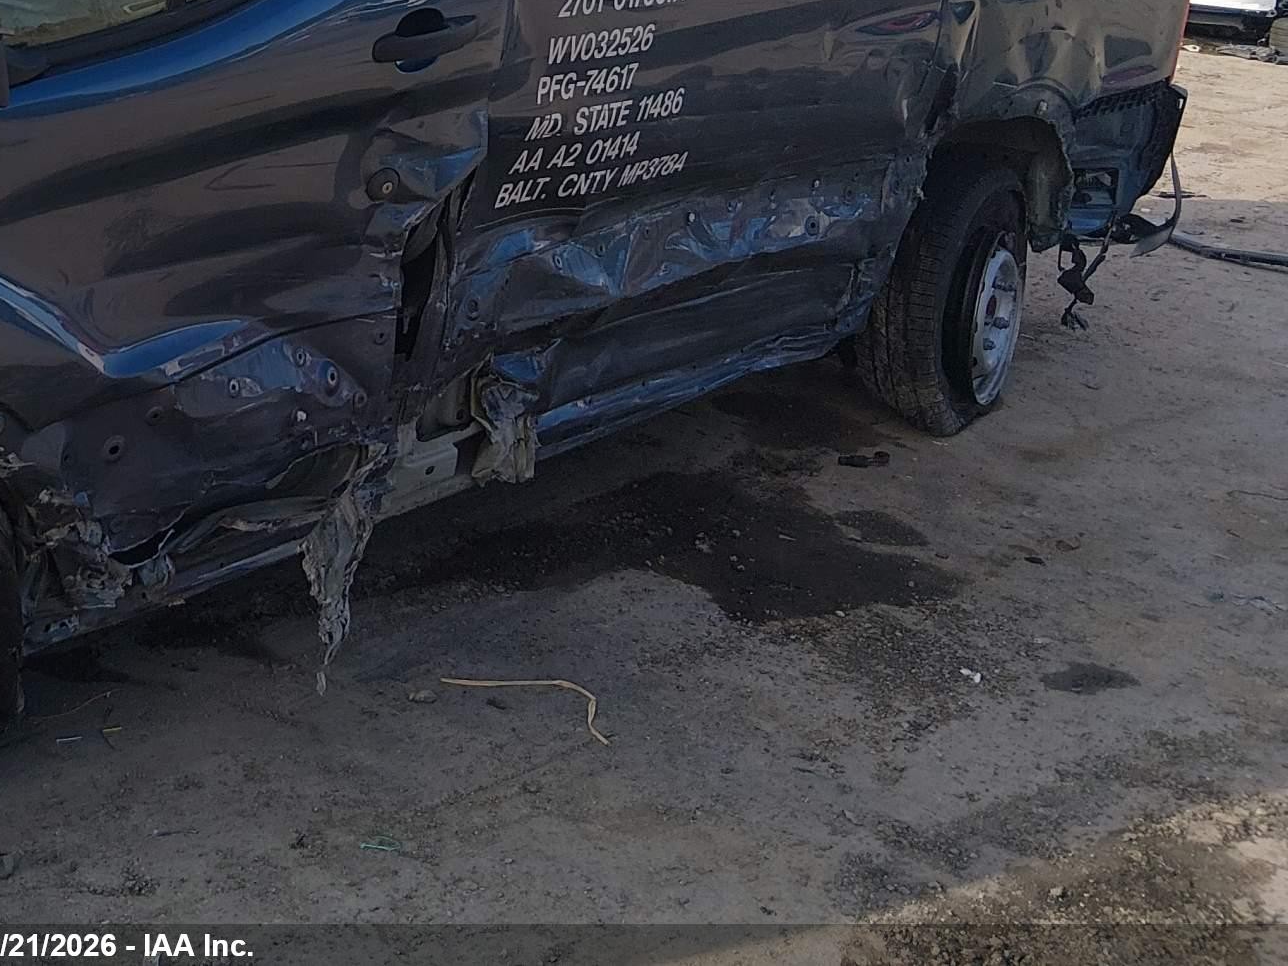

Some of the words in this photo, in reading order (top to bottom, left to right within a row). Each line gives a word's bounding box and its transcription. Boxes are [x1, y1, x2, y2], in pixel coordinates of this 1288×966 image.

[547, 23, 656, 65] WV032526
[536, 62, 640, 105] PFG-74617
[524, 112, 562, 141] MD.
[574, 99, 633, 135] STATE
[636, 87, 684, 122] 11486
[508, 147, 544, 175] AA
[546, 142, 583, 169] A2
[585, 130, 641, 165] 01414
[494, 177, 552, 209] BALT.
[557, 166, 621, 198] CNTY
